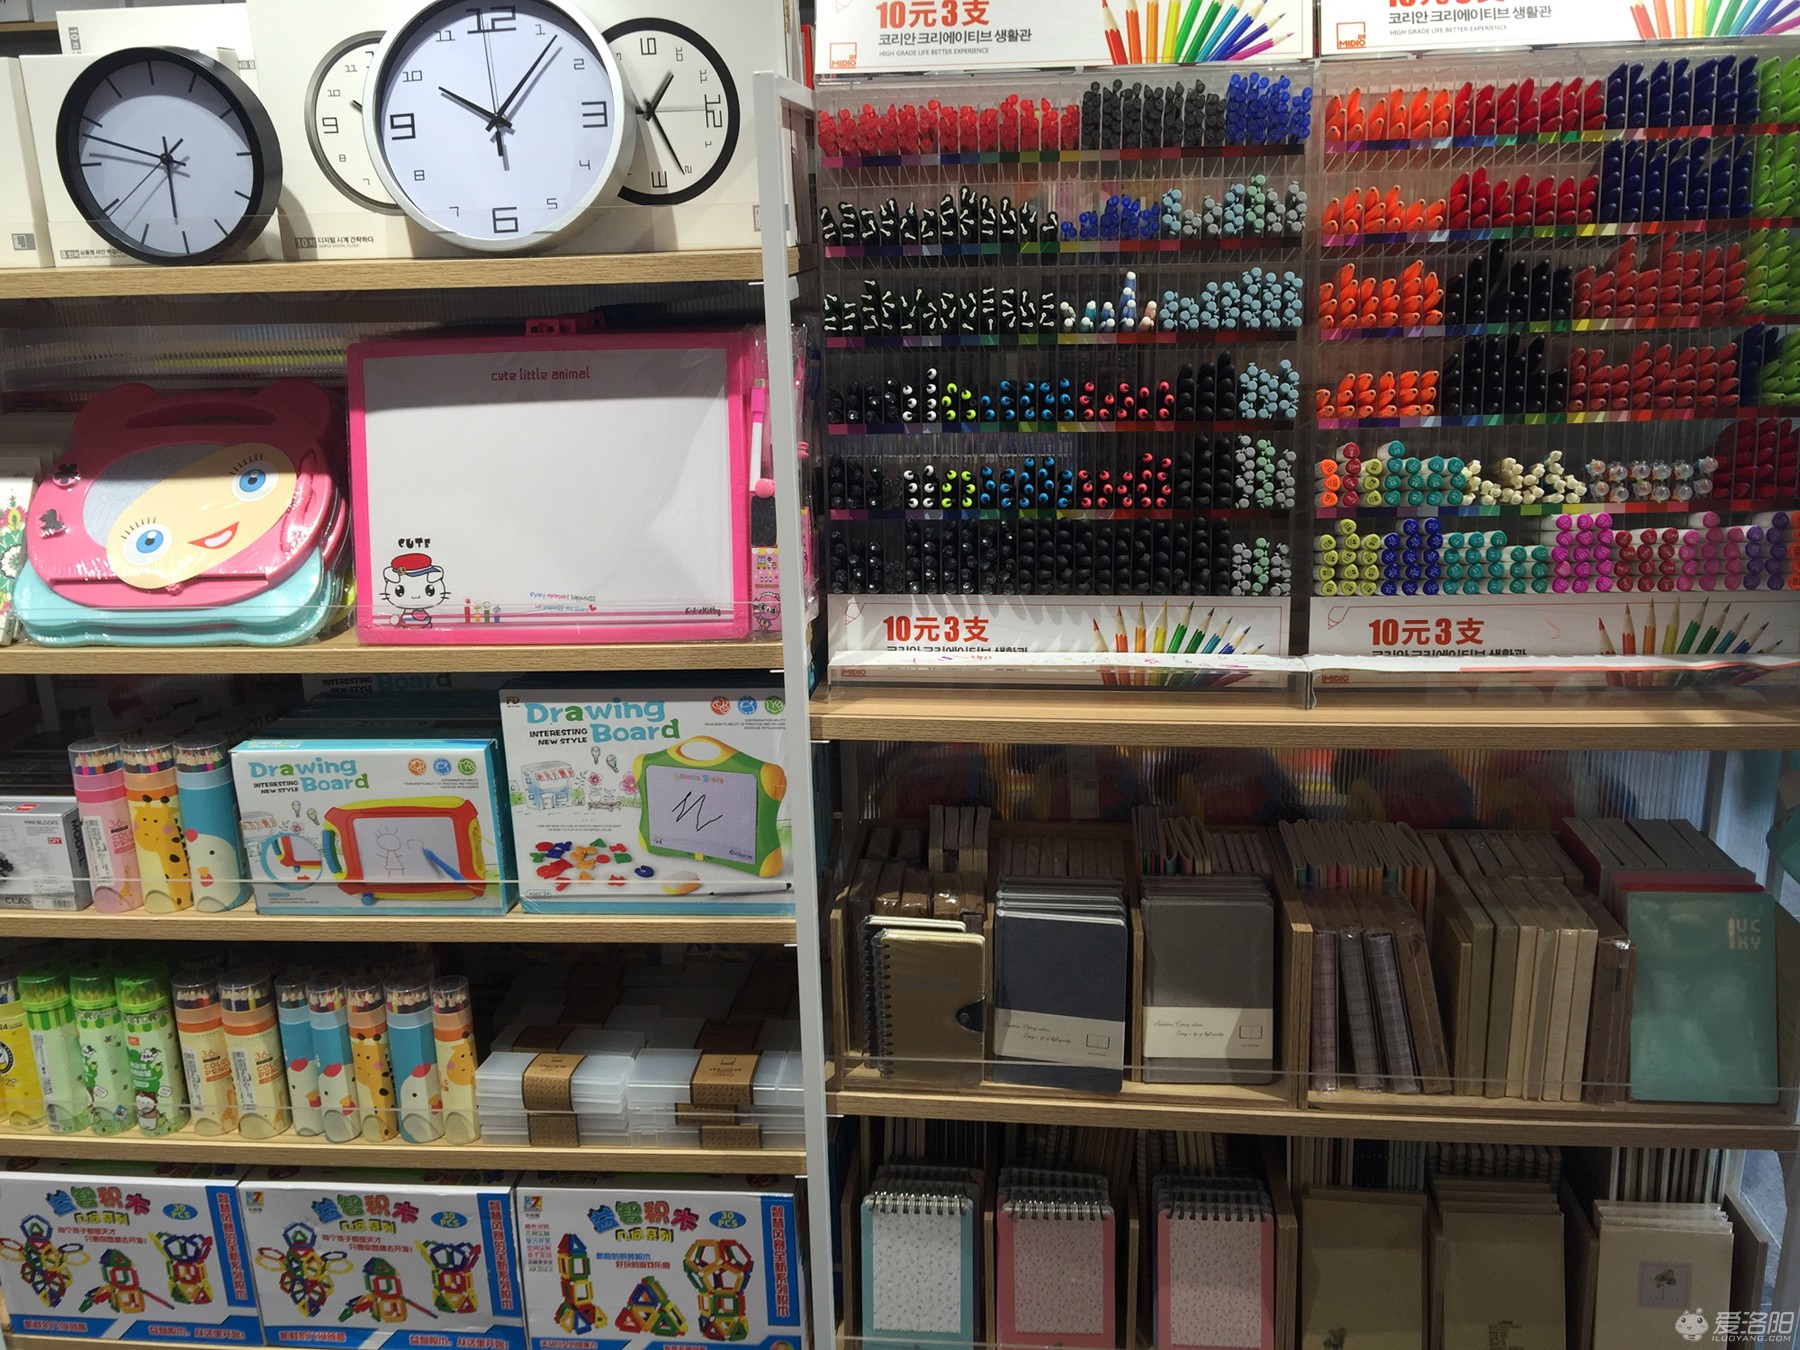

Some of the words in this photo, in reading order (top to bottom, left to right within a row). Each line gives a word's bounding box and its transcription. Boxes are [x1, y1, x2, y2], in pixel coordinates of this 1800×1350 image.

[466, 5, 517, 35] 12
[1388, 12, 1429, 25] 코리안
[1430, 8, 1511, 22] 크리에이티브
[1512, 5, 1553, 20] 생활관
[435, 30, 456, 42] 11
[534, 24, 546, 36] 1
[878, 33, 915, 46] 코리안
[917, 30, 993, 45] 크리에이티브
[994, 29, 1032, 42] 생활관
[896, 49, 917, 57] GRADE
[931, 48, 953, 56] BETTER
[954, 47, 990, 55] EXPERIENCE
[573, 58, 585, 70] 2
[402, 70, 423, 83] 10
[581, 101, 608, 128] 3
[704, 94, 723, 128] 12
[322, 117, 339, 134] 9
[390, 113, 416, 140] 9
[579, 159, 590, 170] 4
[414, 170, 425, 181] 8
[449, 206, 459, 217] 7
[546, 198, 558, 209] 5
[492, 207, 519, 234] 6
[491, 371, 517, 381] cute
[519, 367, 548, 380] little
[551, 366, 590, 380] animal
[398, 537, 431, 549] CUTE
[883, 616, 989, 643] 10元3支
[1369, 617, 1485, 646] 10元3支
[524, 697, 666, 724] Drawing
[529, 728, 588, 738] INTERESTING
[590, 718, 681, 744] Board
[538, 738, 559, 746] NEW
[560, 737, 588, 745] STYLE
[248, 757, 357, 778] Drawing
[253, 780, 299, 788] INTERESTING
[300, 773, 370, 792] Board
[71, 818, 87, 868] MODEL
[46, 1186, 151, 1217] 益智积木
[312, 1194, 419, 1224] 益智积木
[74, 1210, 130, 1226] 几何系列
[587, 1201, 700, 1233] 益智积木
[721, 1211, 734, 1219] 30
[339, 1218, 397, 1234] 几何系列
[439, 1219, 460, 1228] PCS
[718, 1219, 738, 1228] PCS
[616, 1227, 674, 1243] 几何系列
